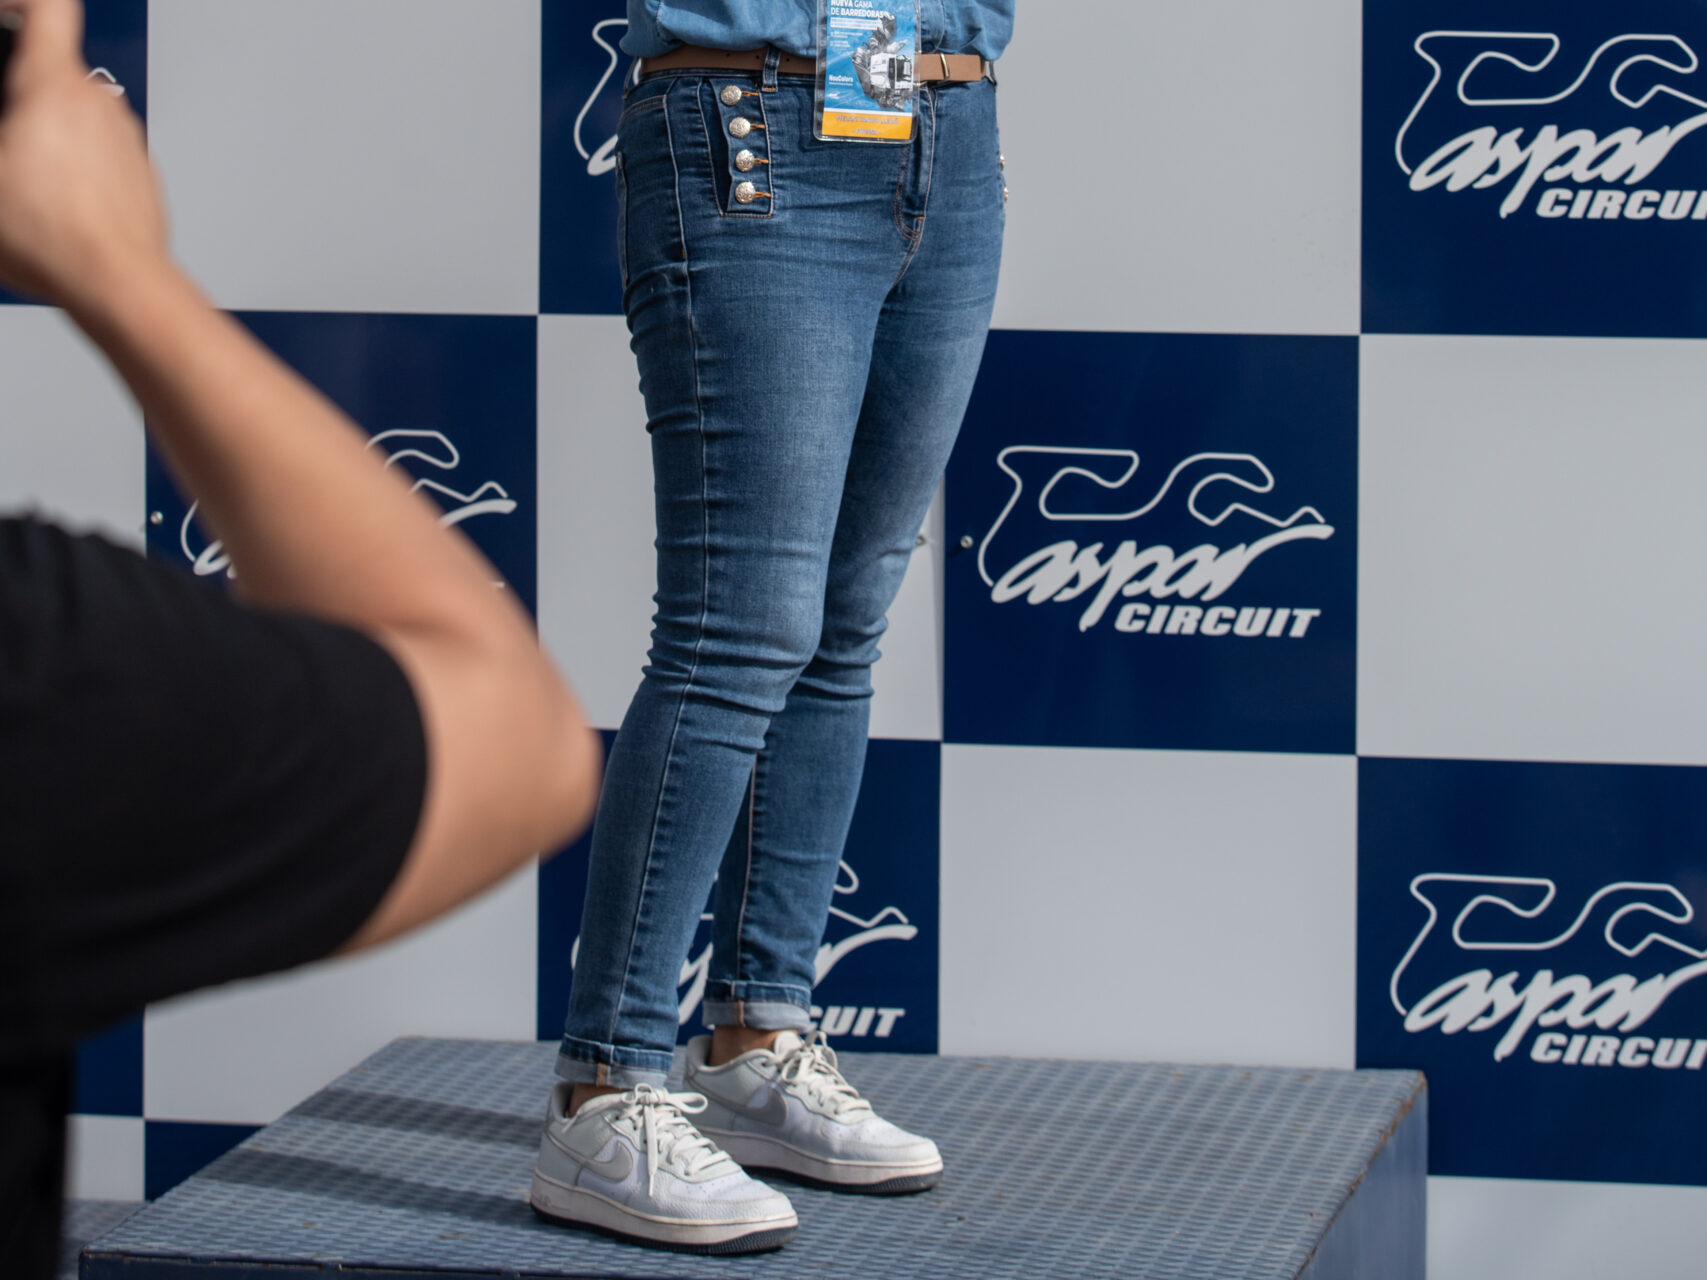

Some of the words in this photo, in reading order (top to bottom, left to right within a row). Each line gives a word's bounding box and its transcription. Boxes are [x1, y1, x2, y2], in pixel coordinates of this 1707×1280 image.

[840, 8, 884, 18] BARREDORAS
[854, 0, 873, 8] GAMA
[1409, 111, 1707, 219] aspar
[1536, 188, 1707, 219] CIRCUI
[991, 524, 1335, 632] aspar
[1114, 603, 1321, 638] CIRCUIT
[1403, 959, 1707, 1062] aspar
[1530, 1032, 1707, 1069] CIRCUI
